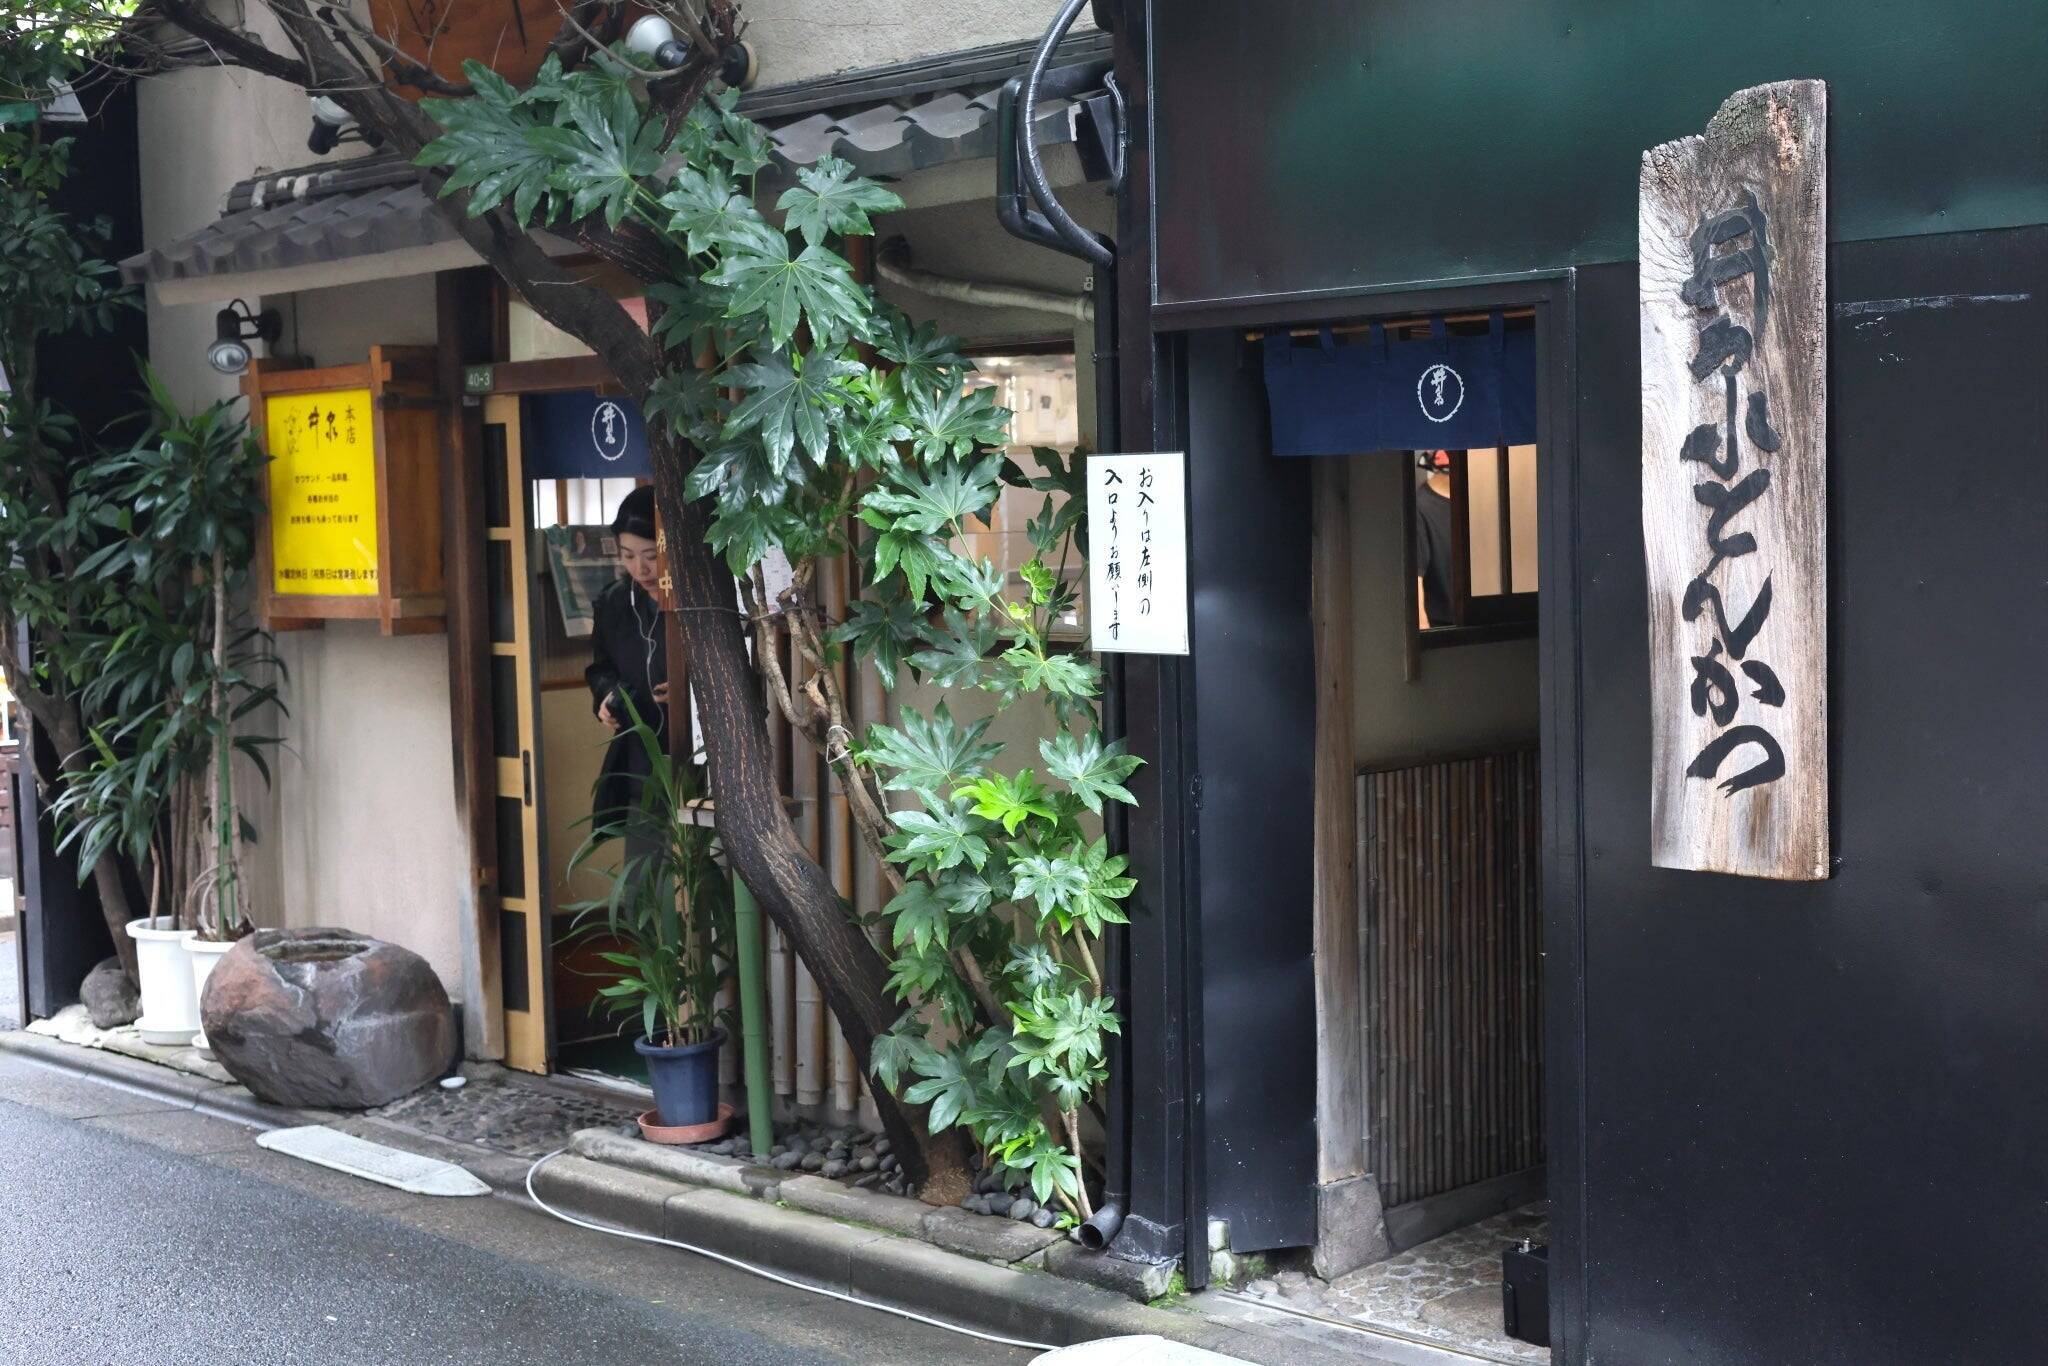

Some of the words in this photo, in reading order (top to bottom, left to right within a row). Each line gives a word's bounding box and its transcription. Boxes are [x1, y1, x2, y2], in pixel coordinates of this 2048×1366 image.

[345, 404, 356, 445] 本店
[467, 372, 491, 387] 40-3
[1104, 468, 1123, 641] 入口よりお願いします
[1137, 467, 1154, 616] お入りは左側の
